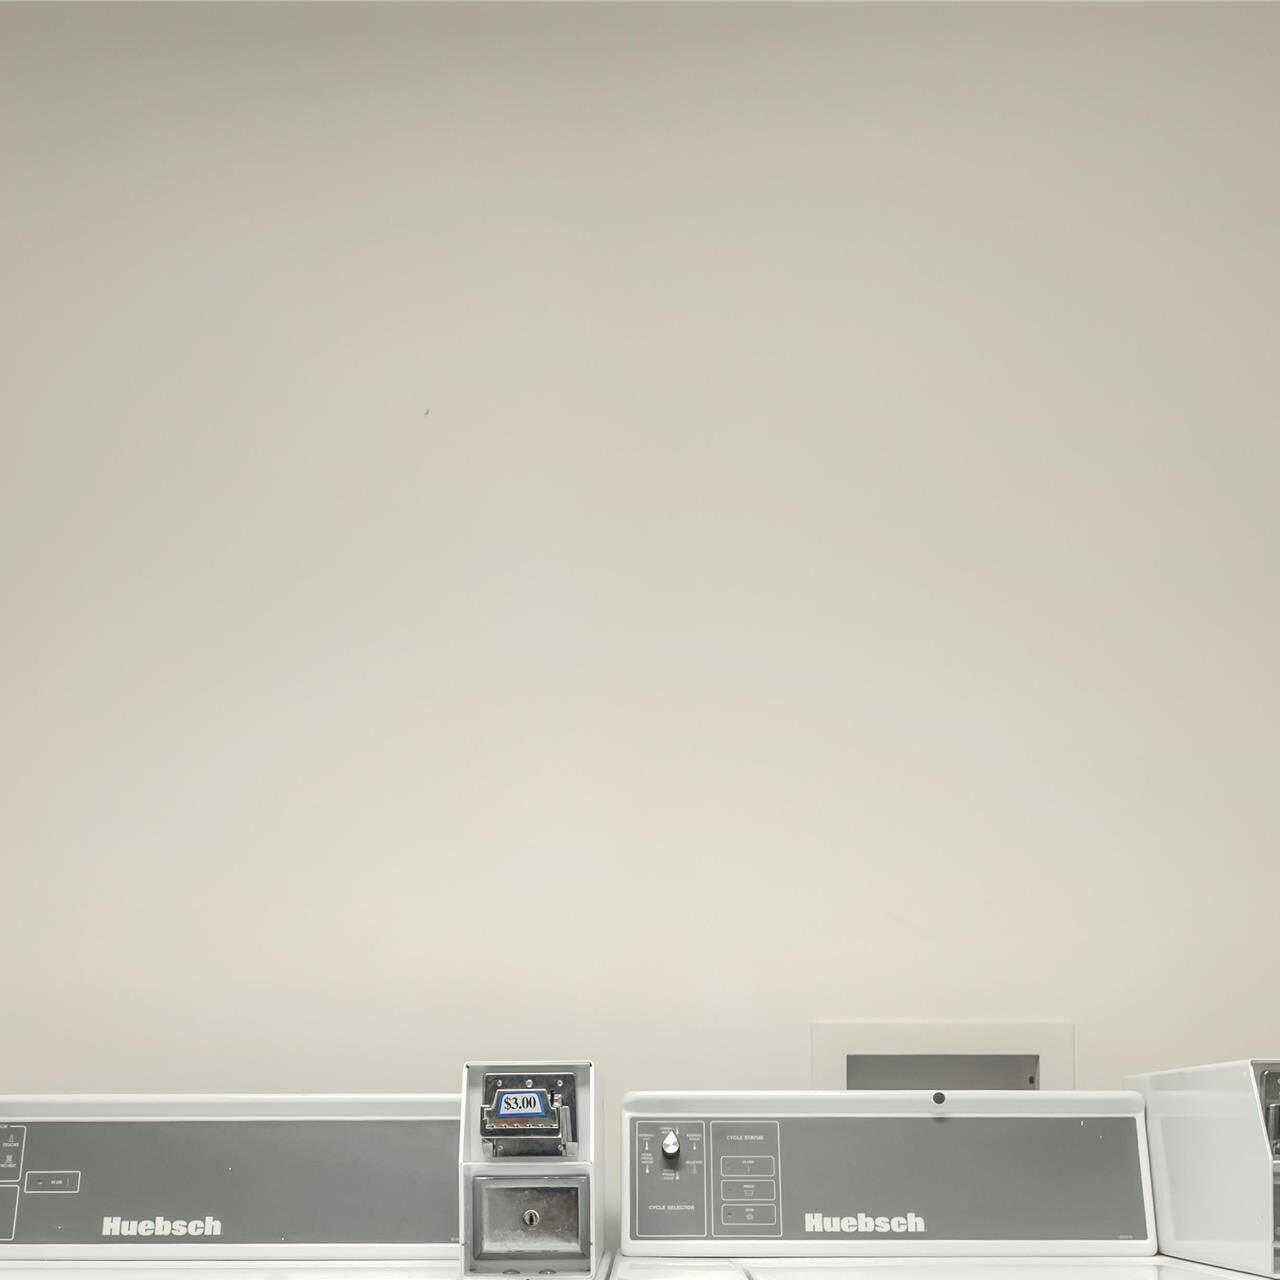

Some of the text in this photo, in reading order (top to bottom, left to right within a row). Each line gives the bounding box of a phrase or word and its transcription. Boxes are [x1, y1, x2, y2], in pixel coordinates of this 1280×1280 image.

[504, 1096, 537, 1111] $3.00
[102, 1216, 222, 1236] Huebsch
[804, 1213, 926, 1233] Huebsch
